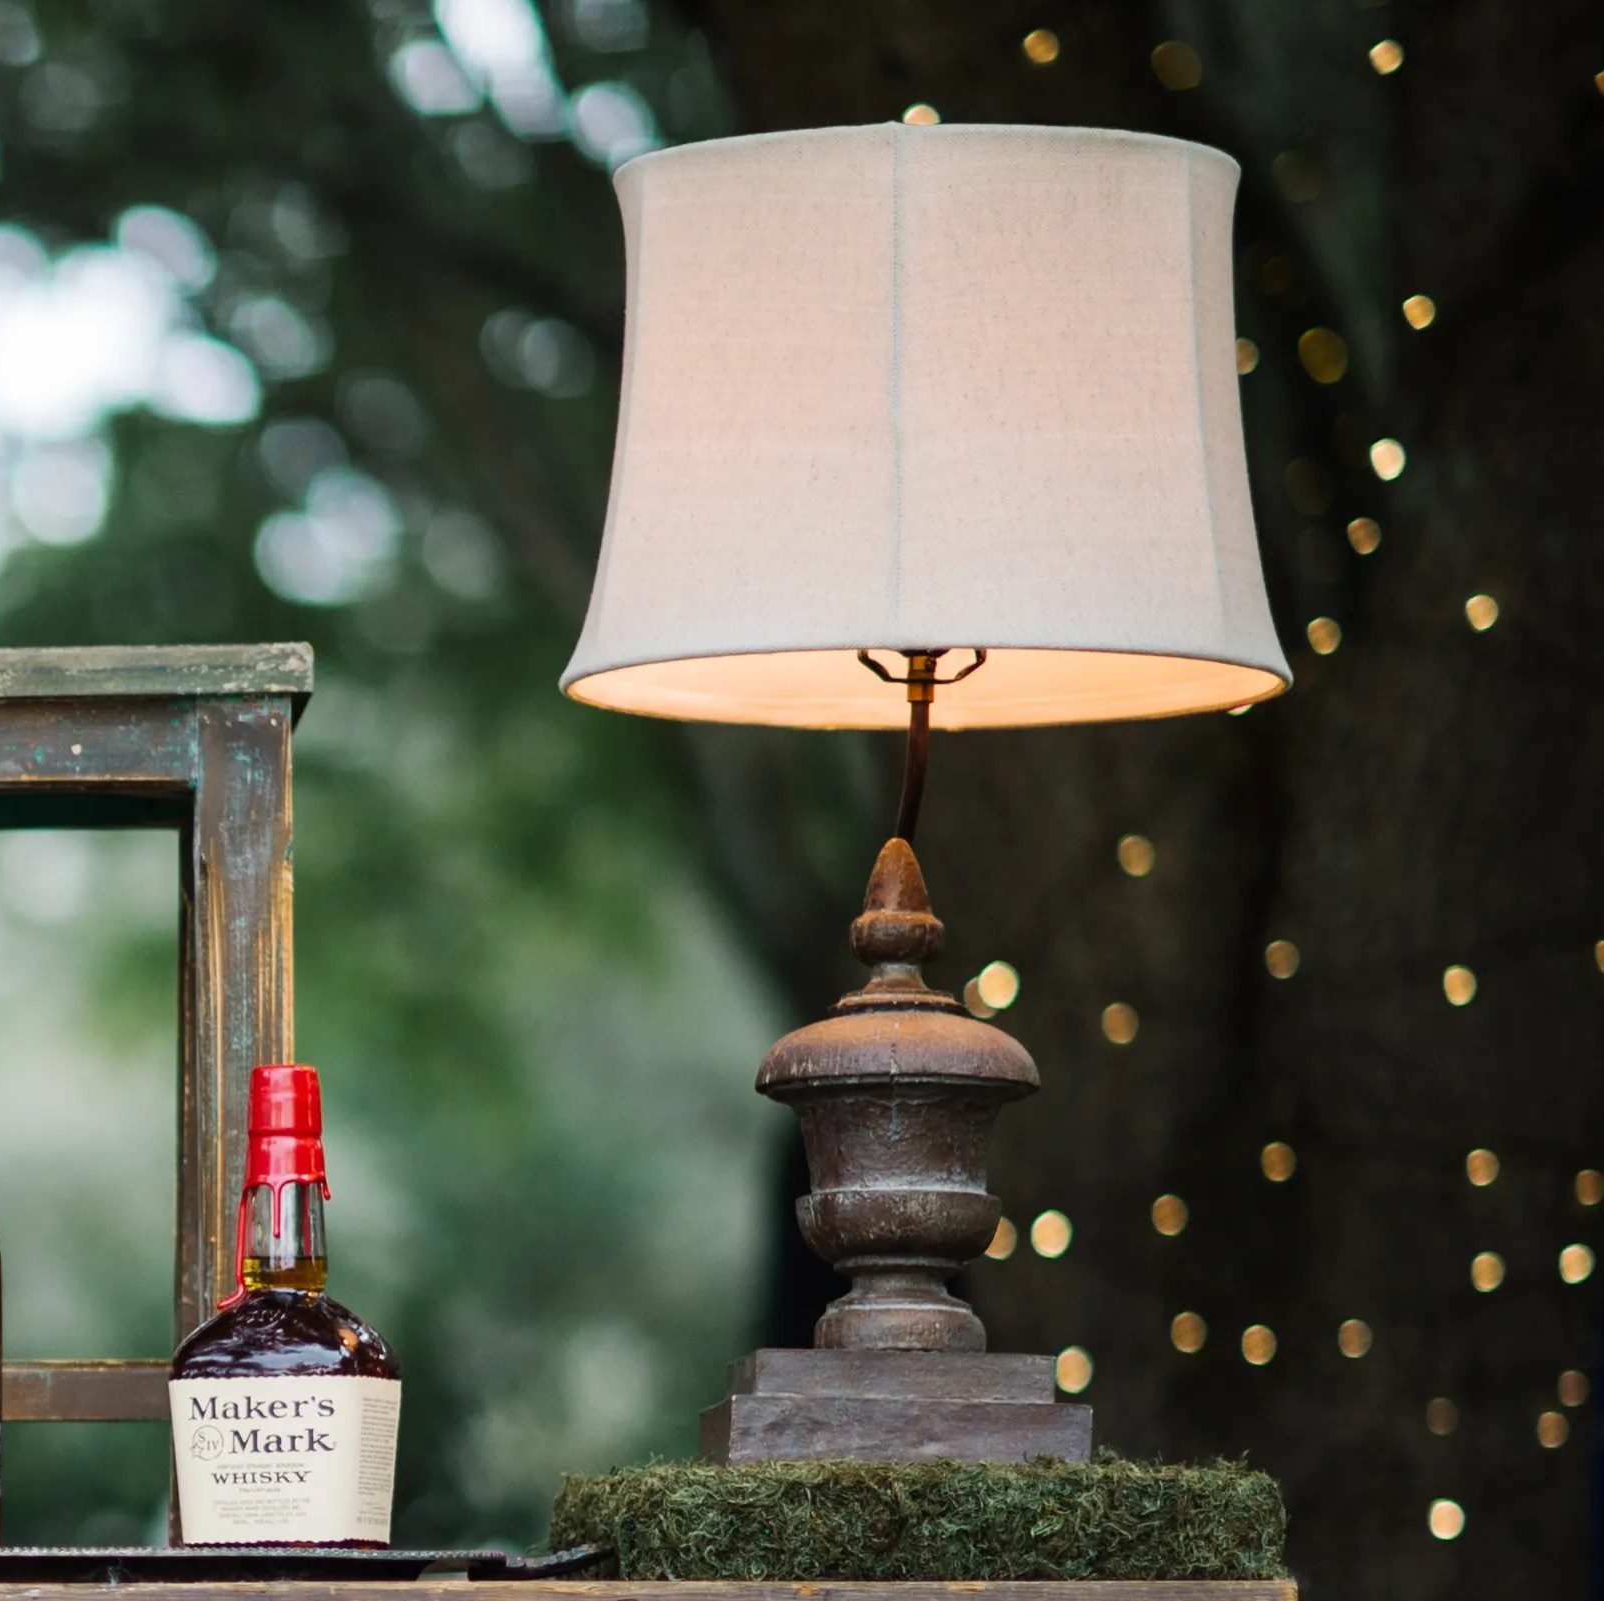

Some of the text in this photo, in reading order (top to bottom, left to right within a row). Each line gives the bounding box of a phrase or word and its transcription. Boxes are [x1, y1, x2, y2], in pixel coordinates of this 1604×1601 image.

[189, 1396, 335, 1421] Maker's
[197, 1431, 206, 1443] S
[229, 1428, 335, 1454] Mark
[210, 1471, 313, 1485] WHISKY
